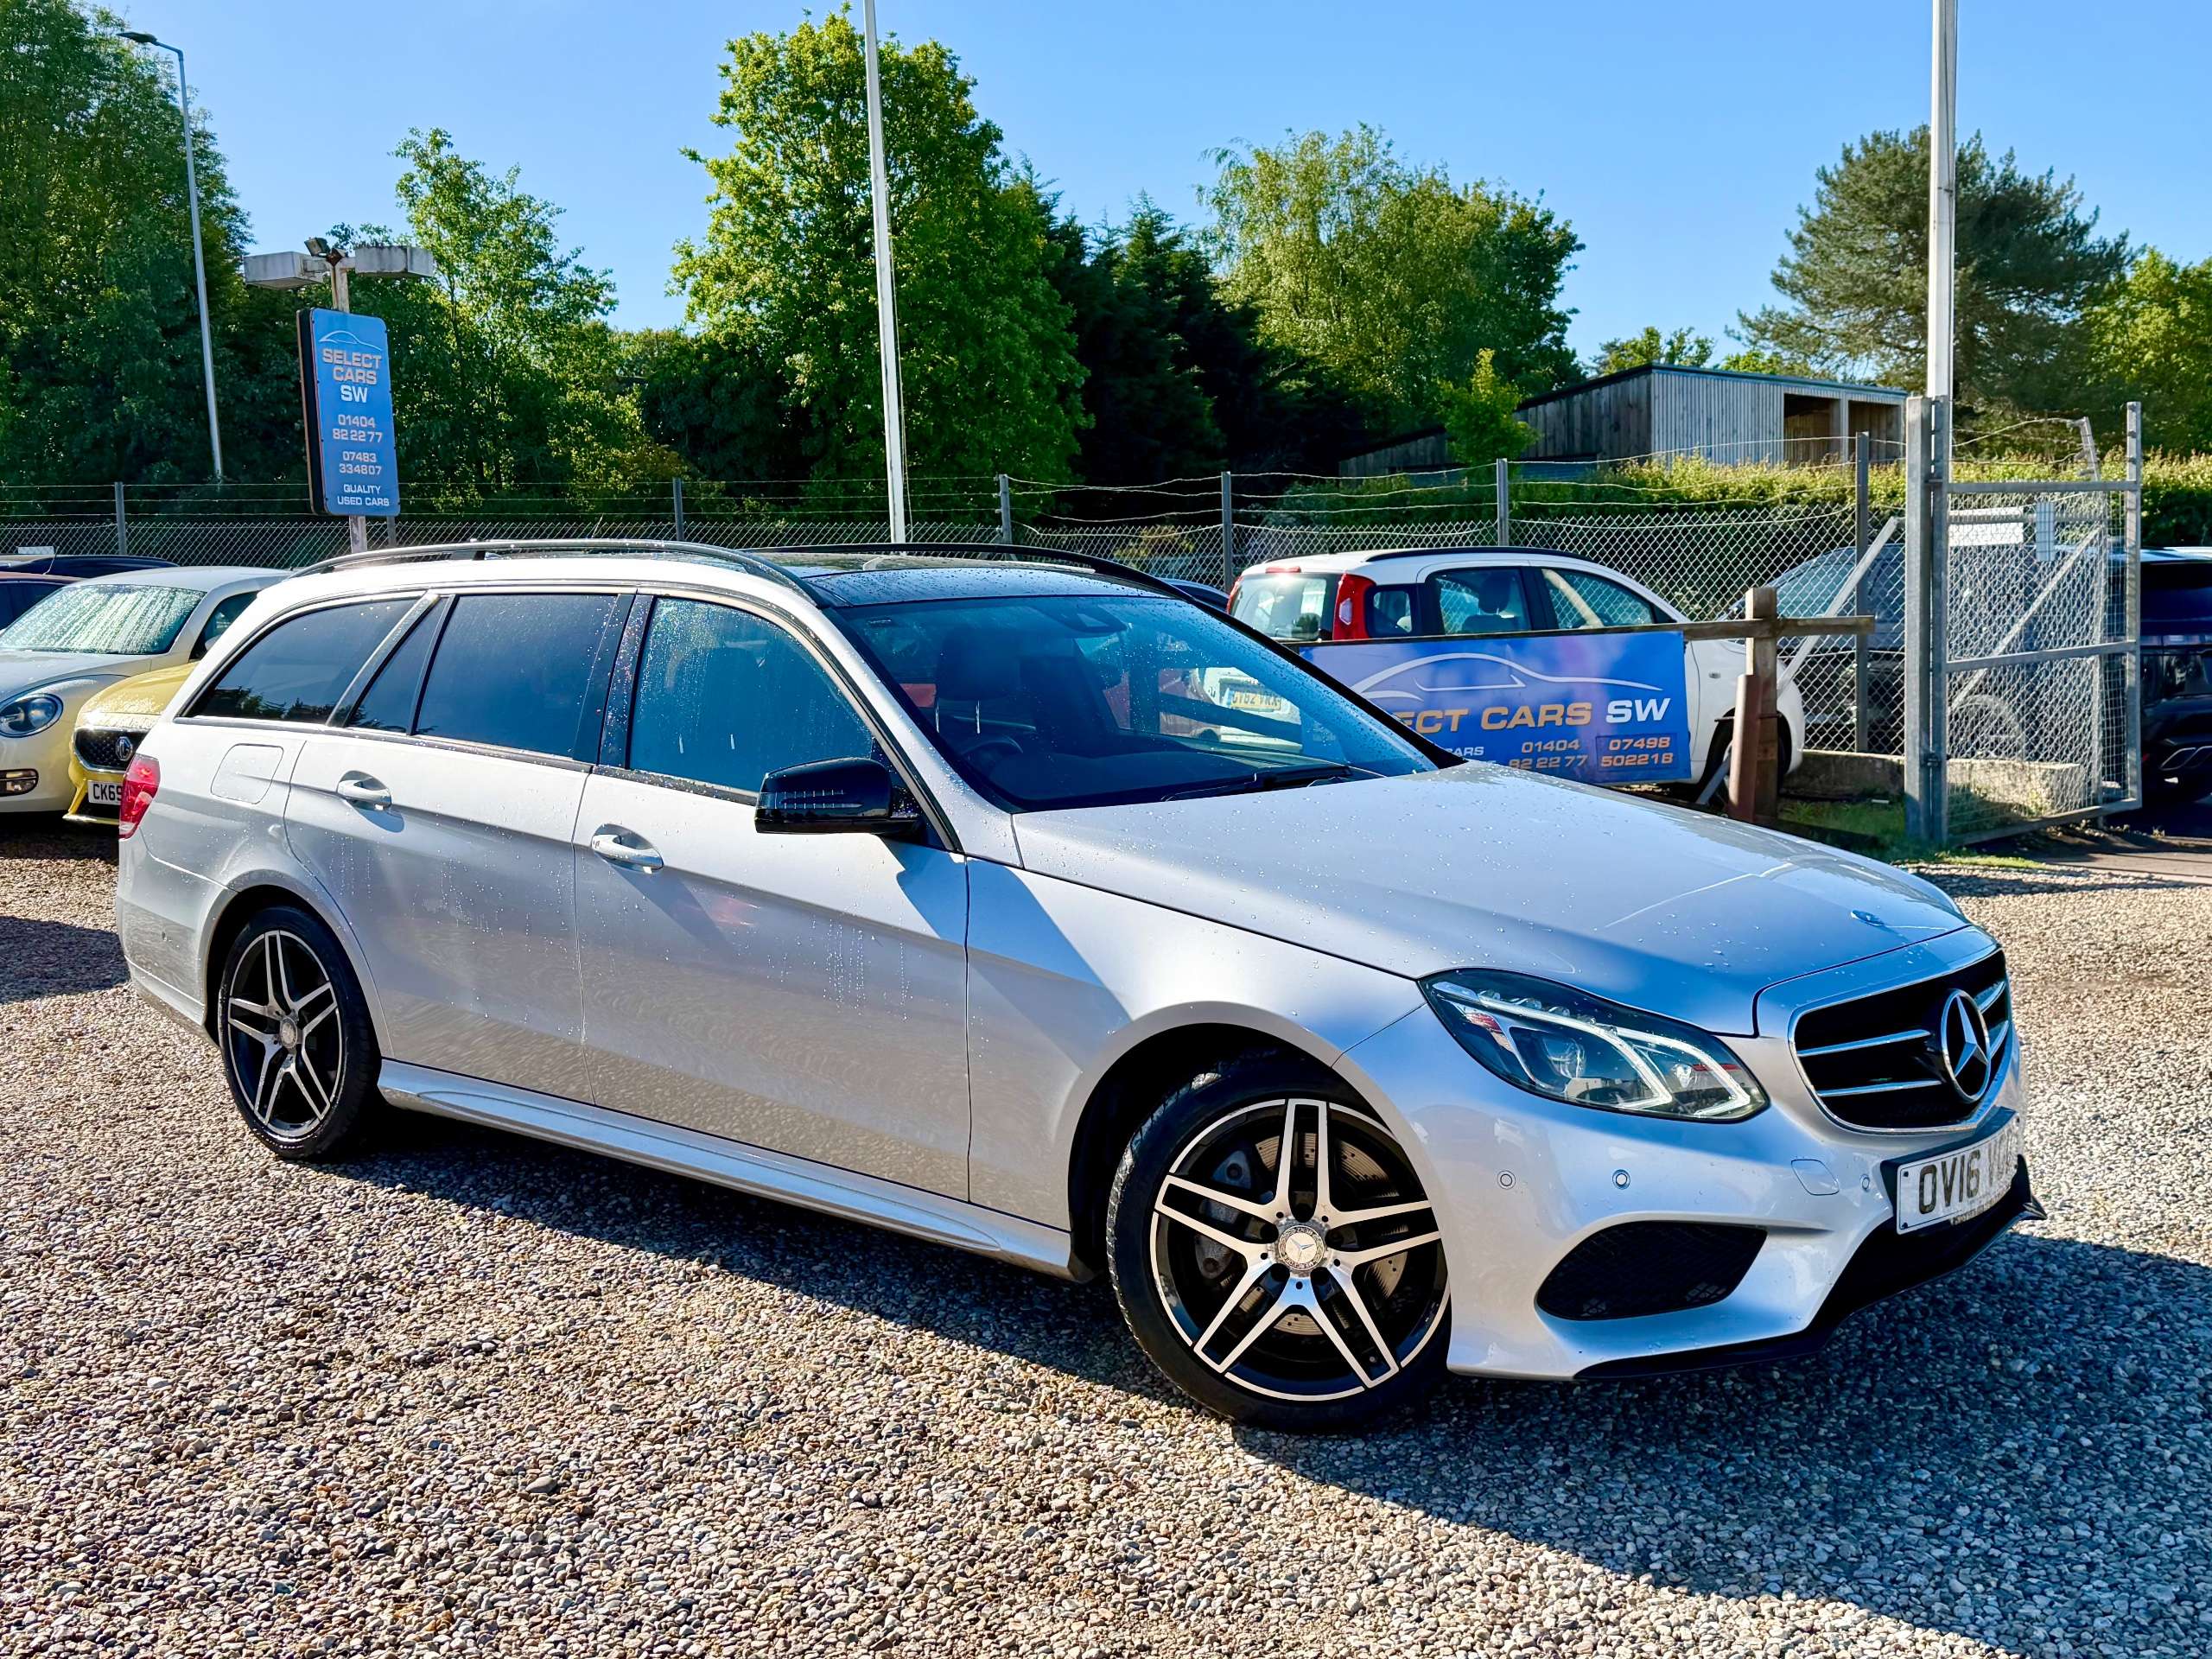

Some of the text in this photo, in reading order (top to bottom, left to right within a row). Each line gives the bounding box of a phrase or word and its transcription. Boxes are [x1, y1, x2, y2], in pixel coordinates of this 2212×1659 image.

[322, 348, 382, 369] SELECT
[333, 365, 378, 385] CARS
[340, 384, 368, 403] SW
[338, 414, 376, 428] 01404
[342, 450, 377, 463] 07483
[339, 463, 382, 475] 334807
[343, 483, 381, 494] QUALITY
[337, 495, 390, 506] USED CARS
[1480, 702, 1592, 731] CARS
[1605, 697, 1671, 724] SW
[1521, 739, 1580, 753] 01404
[1609, 736, 1671, 751] 07498
[1601, 752, 1674, 767] 502218
[1919, 1149, 1981, 1215] OV16
